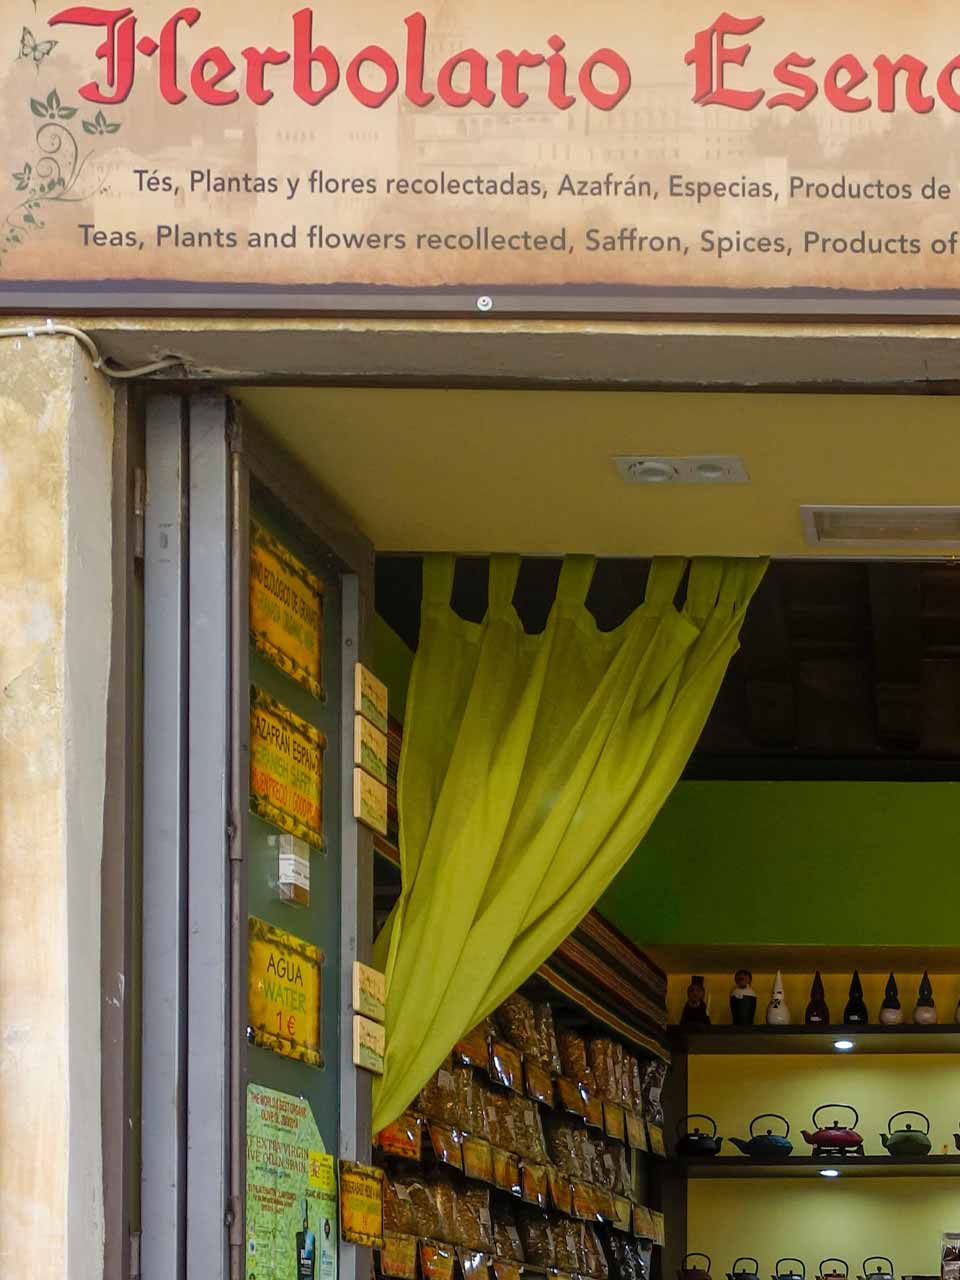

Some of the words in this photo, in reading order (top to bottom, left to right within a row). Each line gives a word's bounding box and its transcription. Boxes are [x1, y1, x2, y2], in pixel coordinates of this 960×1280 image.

[48, 6, 631, 110] Herbolario
[133, 168, 181, 197] Tés,
[189, 170, 279, 196] Plantas
[287, 178, 300, 200] y
[309, 170, 377, 195] flores
[385, 172, 549, 198] recolectadas,
[557, 172, 660, 200] Azafrán,
[669, 174, 779, 203] Especias,
[789, 174, 913, 200] Productos
[921, 176, 951, 201] de
[78, 224, 145, 252] Teas,
[155, 224, 238, 250] Plants
[247, 225, 297, 250] and
[307, 225, 406, 251] flowers
[415, 226, 574, 255] recollected,
[585, 228, 689, 256] Saffron,
[700, 229, 793, 258] Spices,
[804, 230, 920, 256] Products
[929, 230, 959, 256] of
[267, 953, 303, 987] AGUA
[263, 976, 307, 1014] WATER
[276, 1011, 283, 1031] 1
[287, 1015, 296, 1036] €
